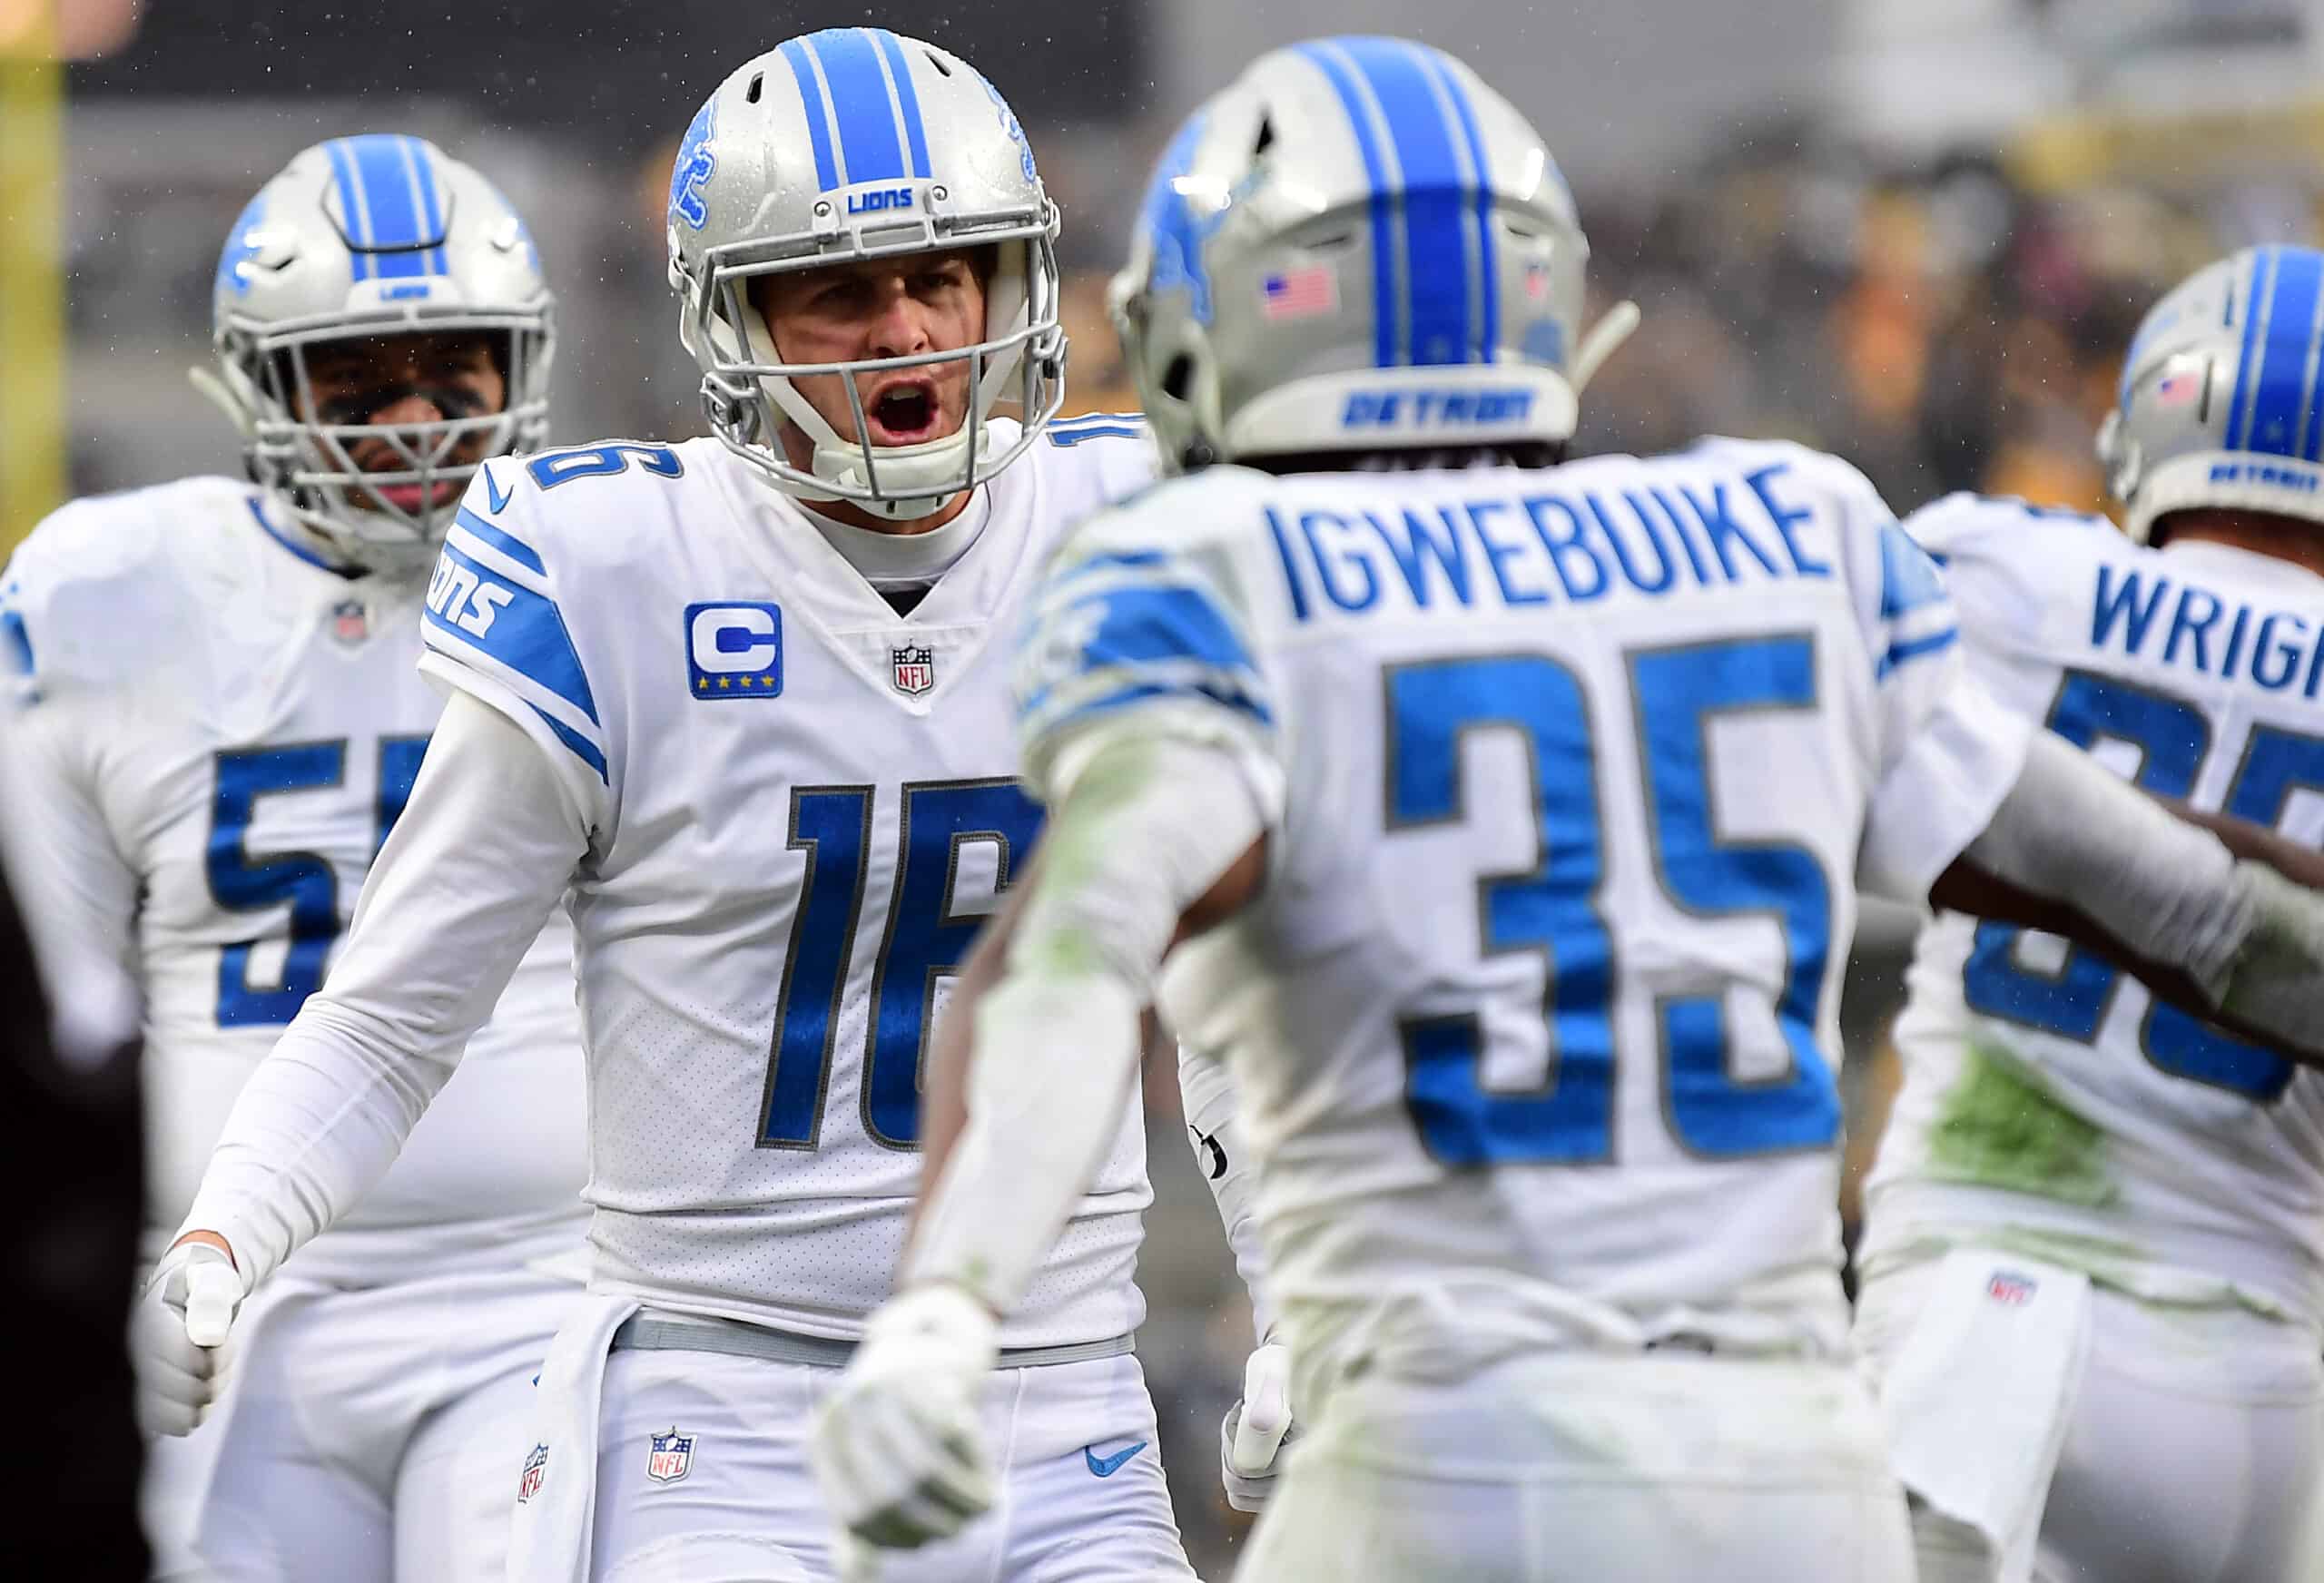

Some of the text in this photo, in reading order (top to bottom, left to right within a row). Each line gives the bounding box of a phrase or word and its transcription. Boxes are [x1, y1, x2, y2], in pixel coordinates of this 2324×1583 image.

[848, 187, 913, 213] LIONS
[1263, 465, 1832, 623] IGWEBUIKE
[692, 607, 777, 674] C
[897, 666, 931, 688] NFL
[1381, 630, 1845, 1167] 35
[652, 1453, 683, 1476] NFL
[520, 1469, 542, 1499] NFL
